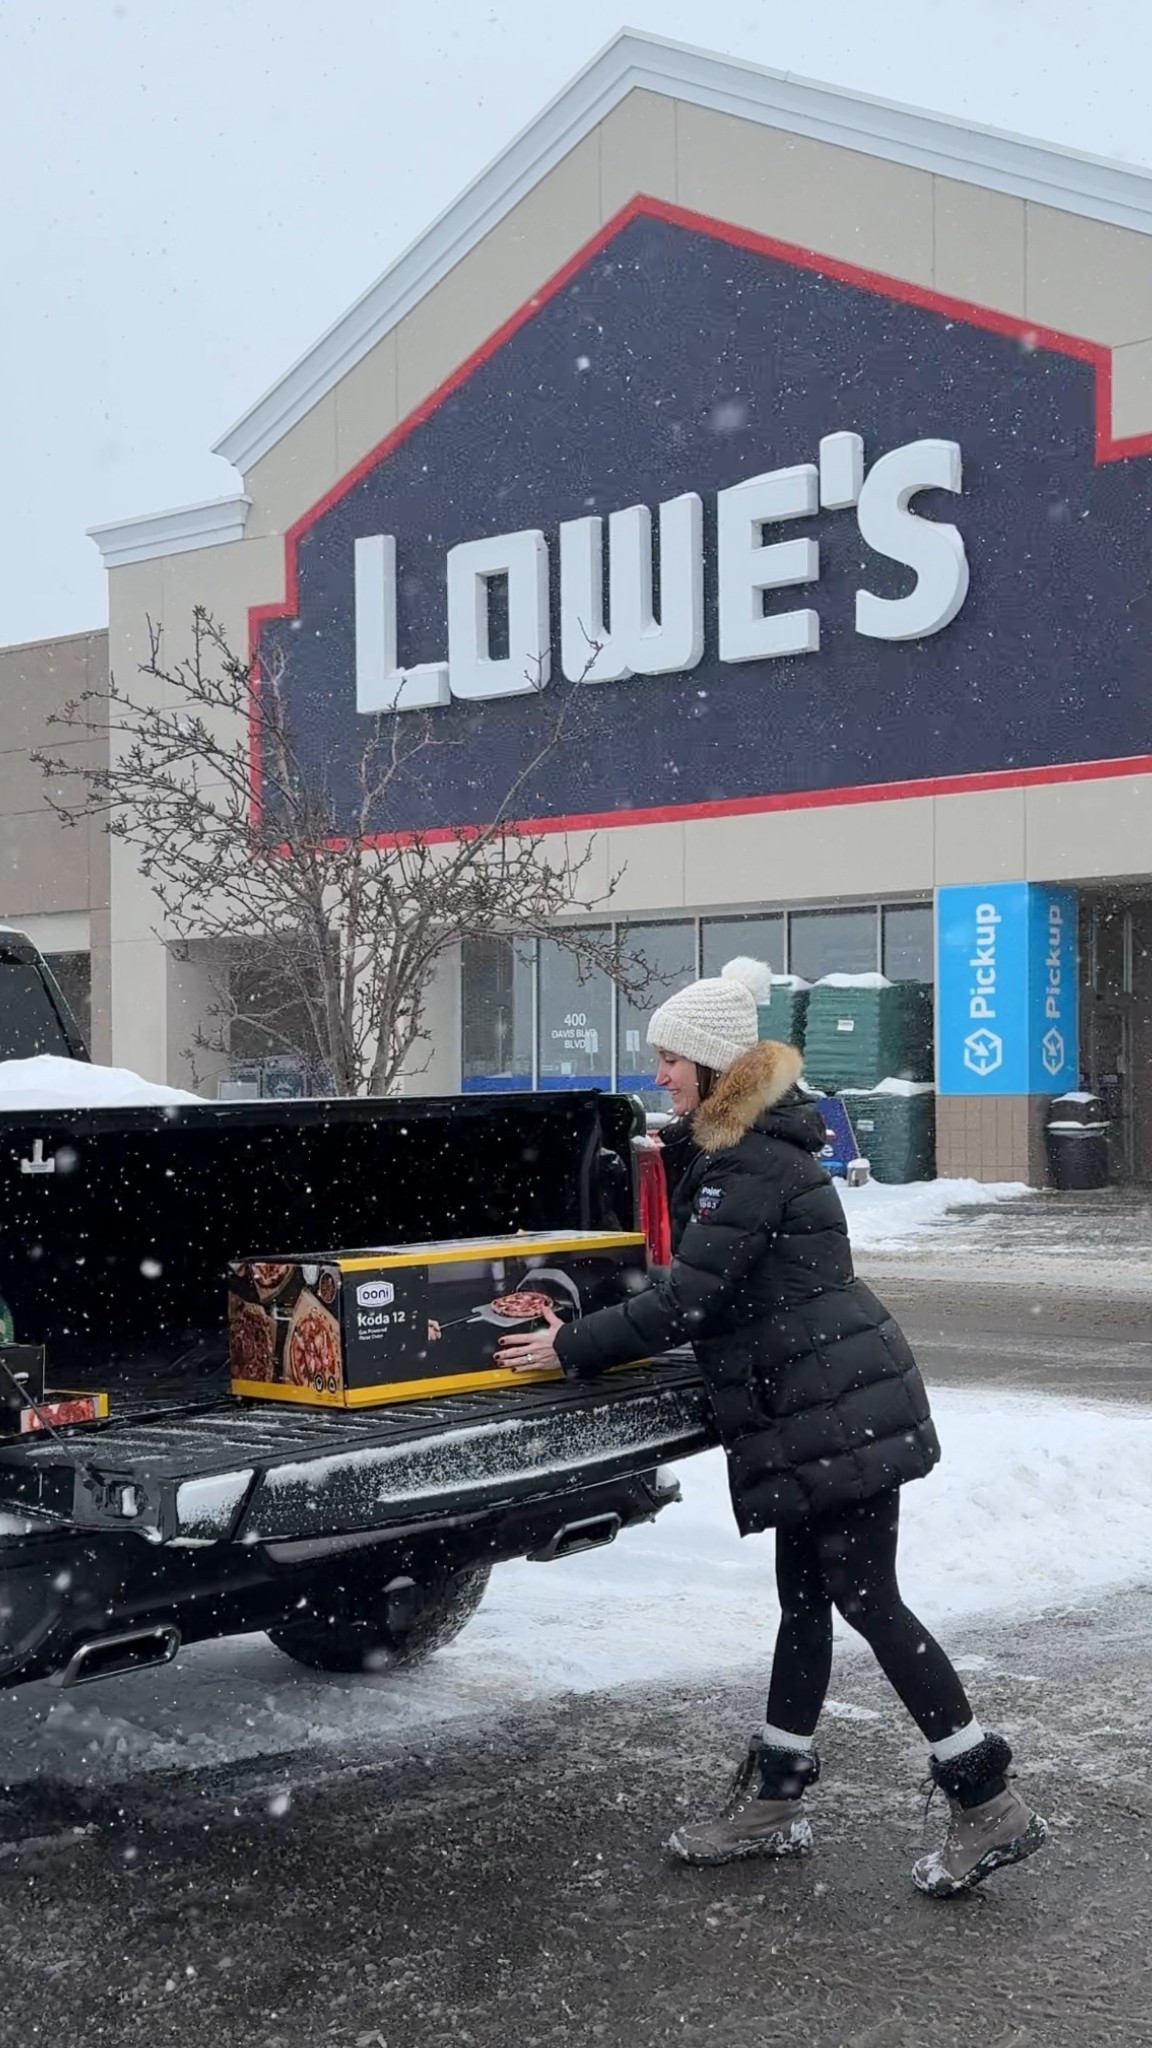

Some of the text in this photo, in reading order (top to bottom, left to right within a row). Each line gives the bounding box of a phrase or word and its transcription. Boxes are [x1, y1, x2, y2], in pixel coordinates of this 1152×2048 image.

[354, 430, 970, 714] LOWE'S
[969, 903, 1001, 1018] Pickup
[1046, 904, 1063, 1018] Pickup
[563, 1013, 587, 1026] 400
[551, 1029, 575, 1039] DAVIS
[564, 1039, 586, 1049] BLVD
[362, 1287, 389, 1300] ooni
[357, 1311, 406, 1327] Koda 12
